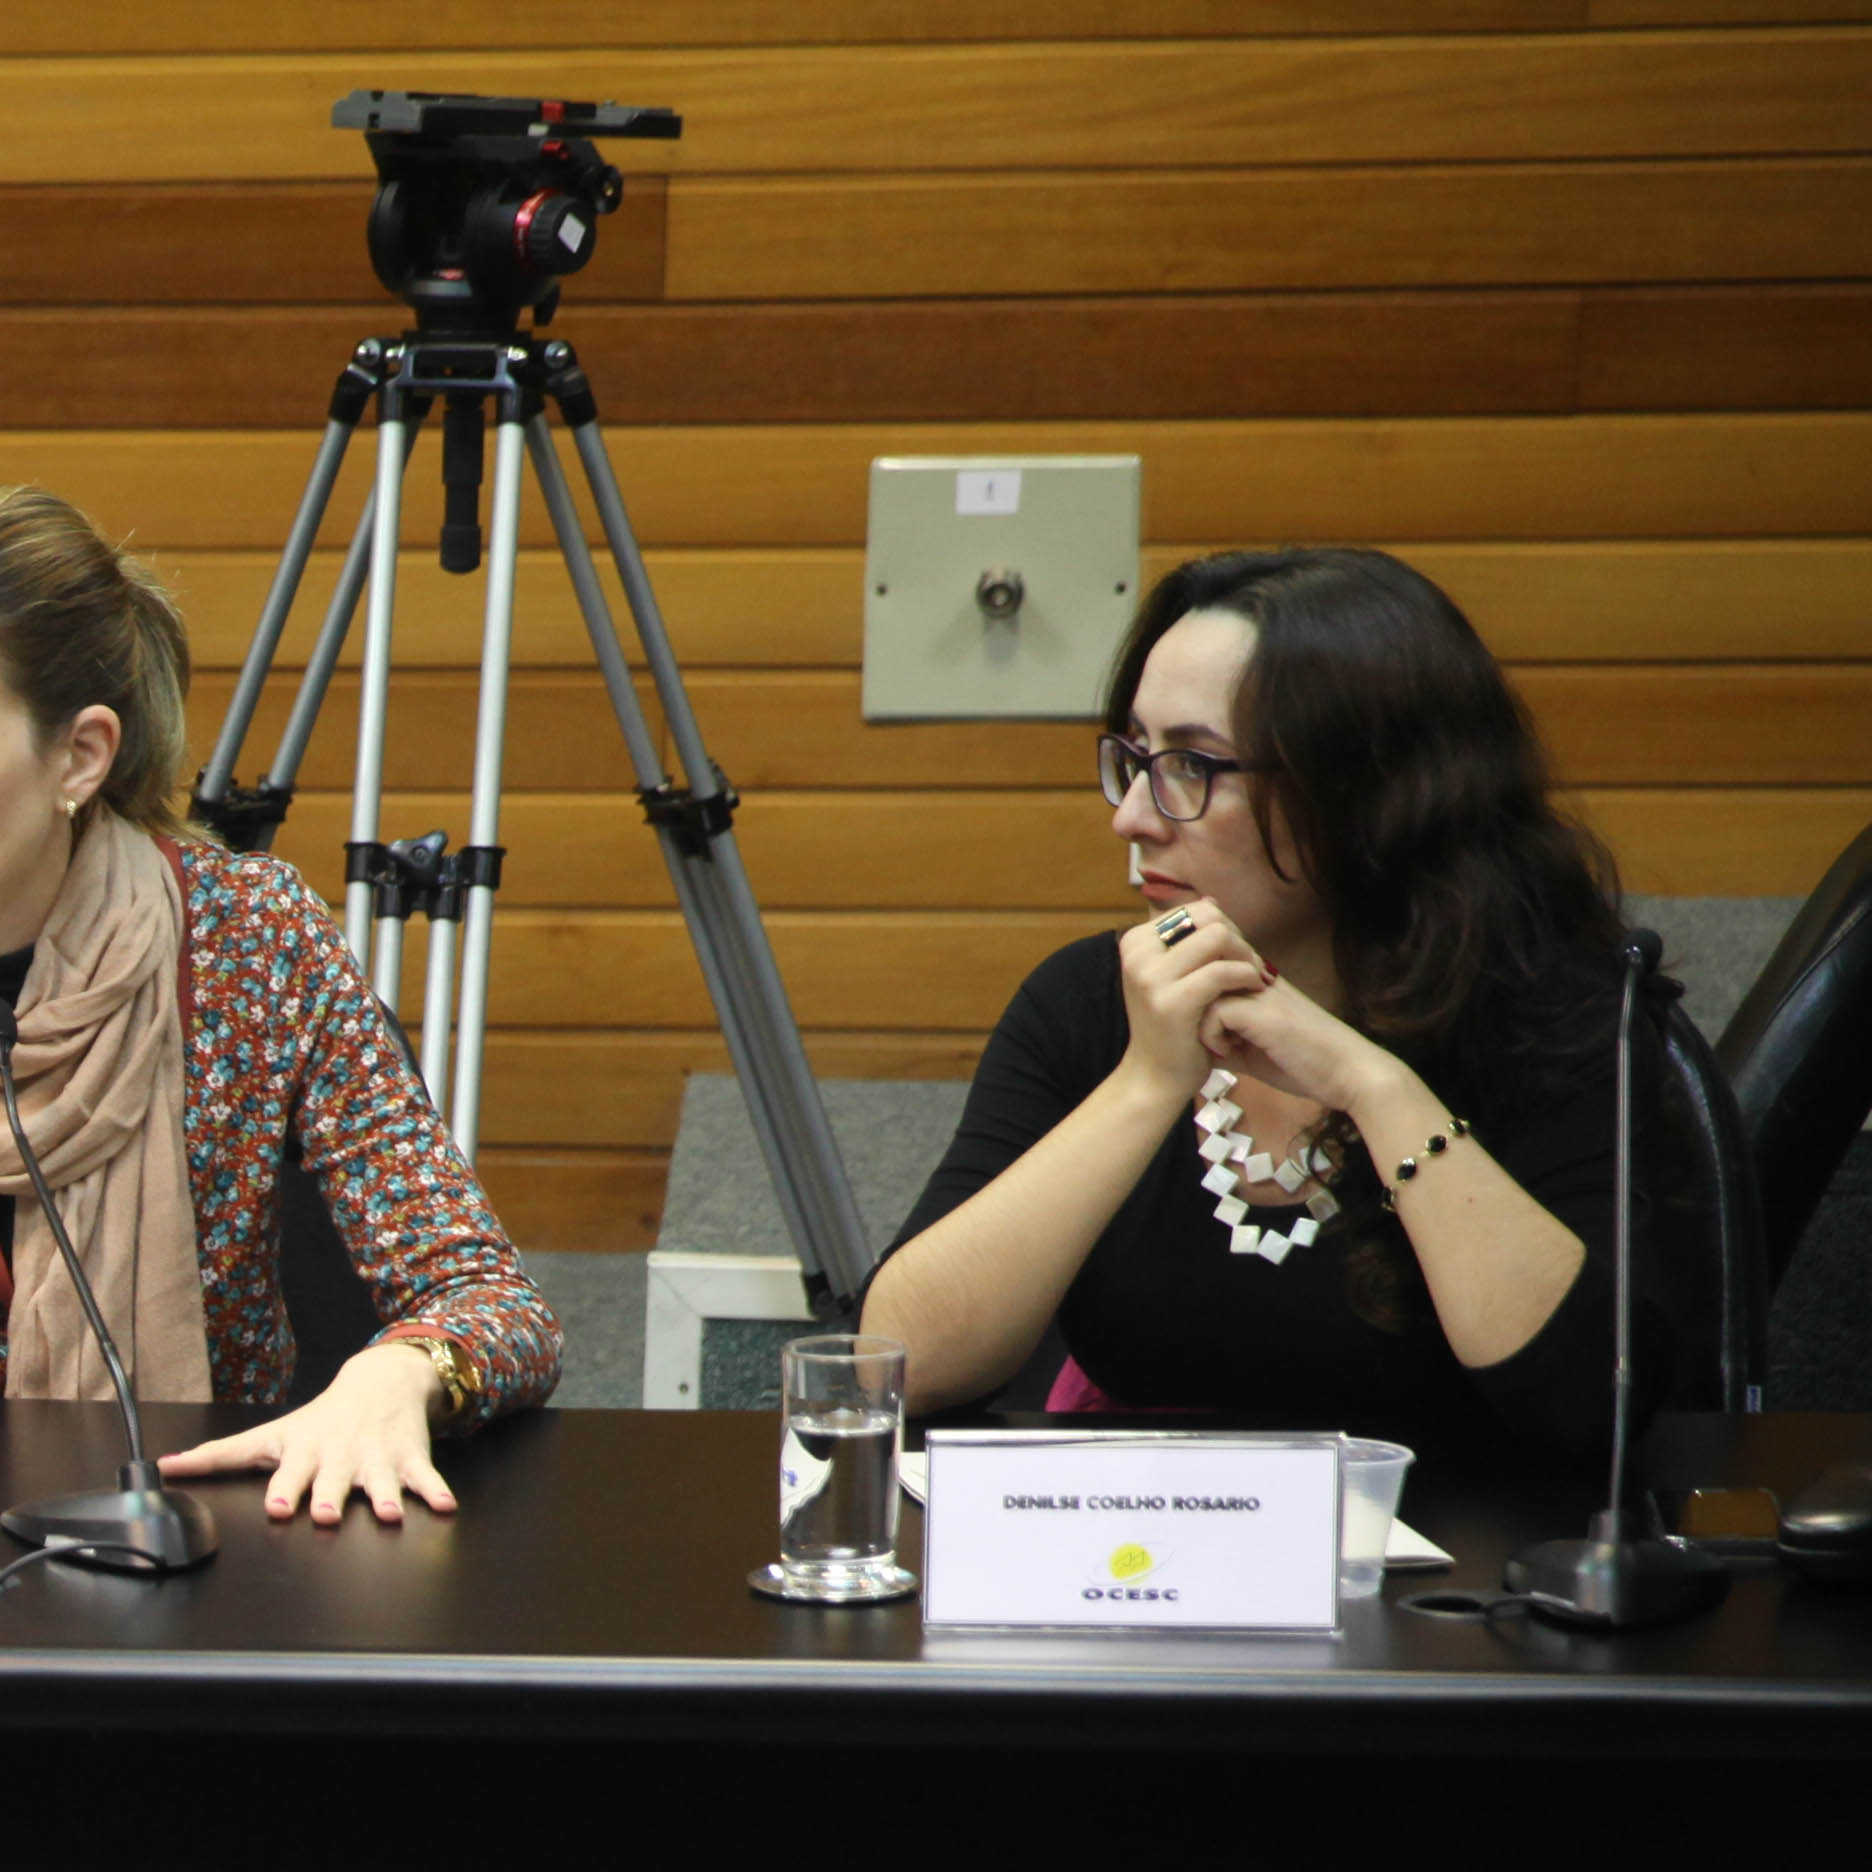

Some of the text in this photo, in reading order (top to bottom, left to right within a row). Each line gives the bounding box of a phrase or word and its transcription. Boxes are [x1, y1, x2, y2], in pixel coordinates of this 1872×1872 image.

[1002, 1494, 1261, 1512] DENILSE COELHO ROSARIO
[1081, 1587, 1180, 1601] OCESC
